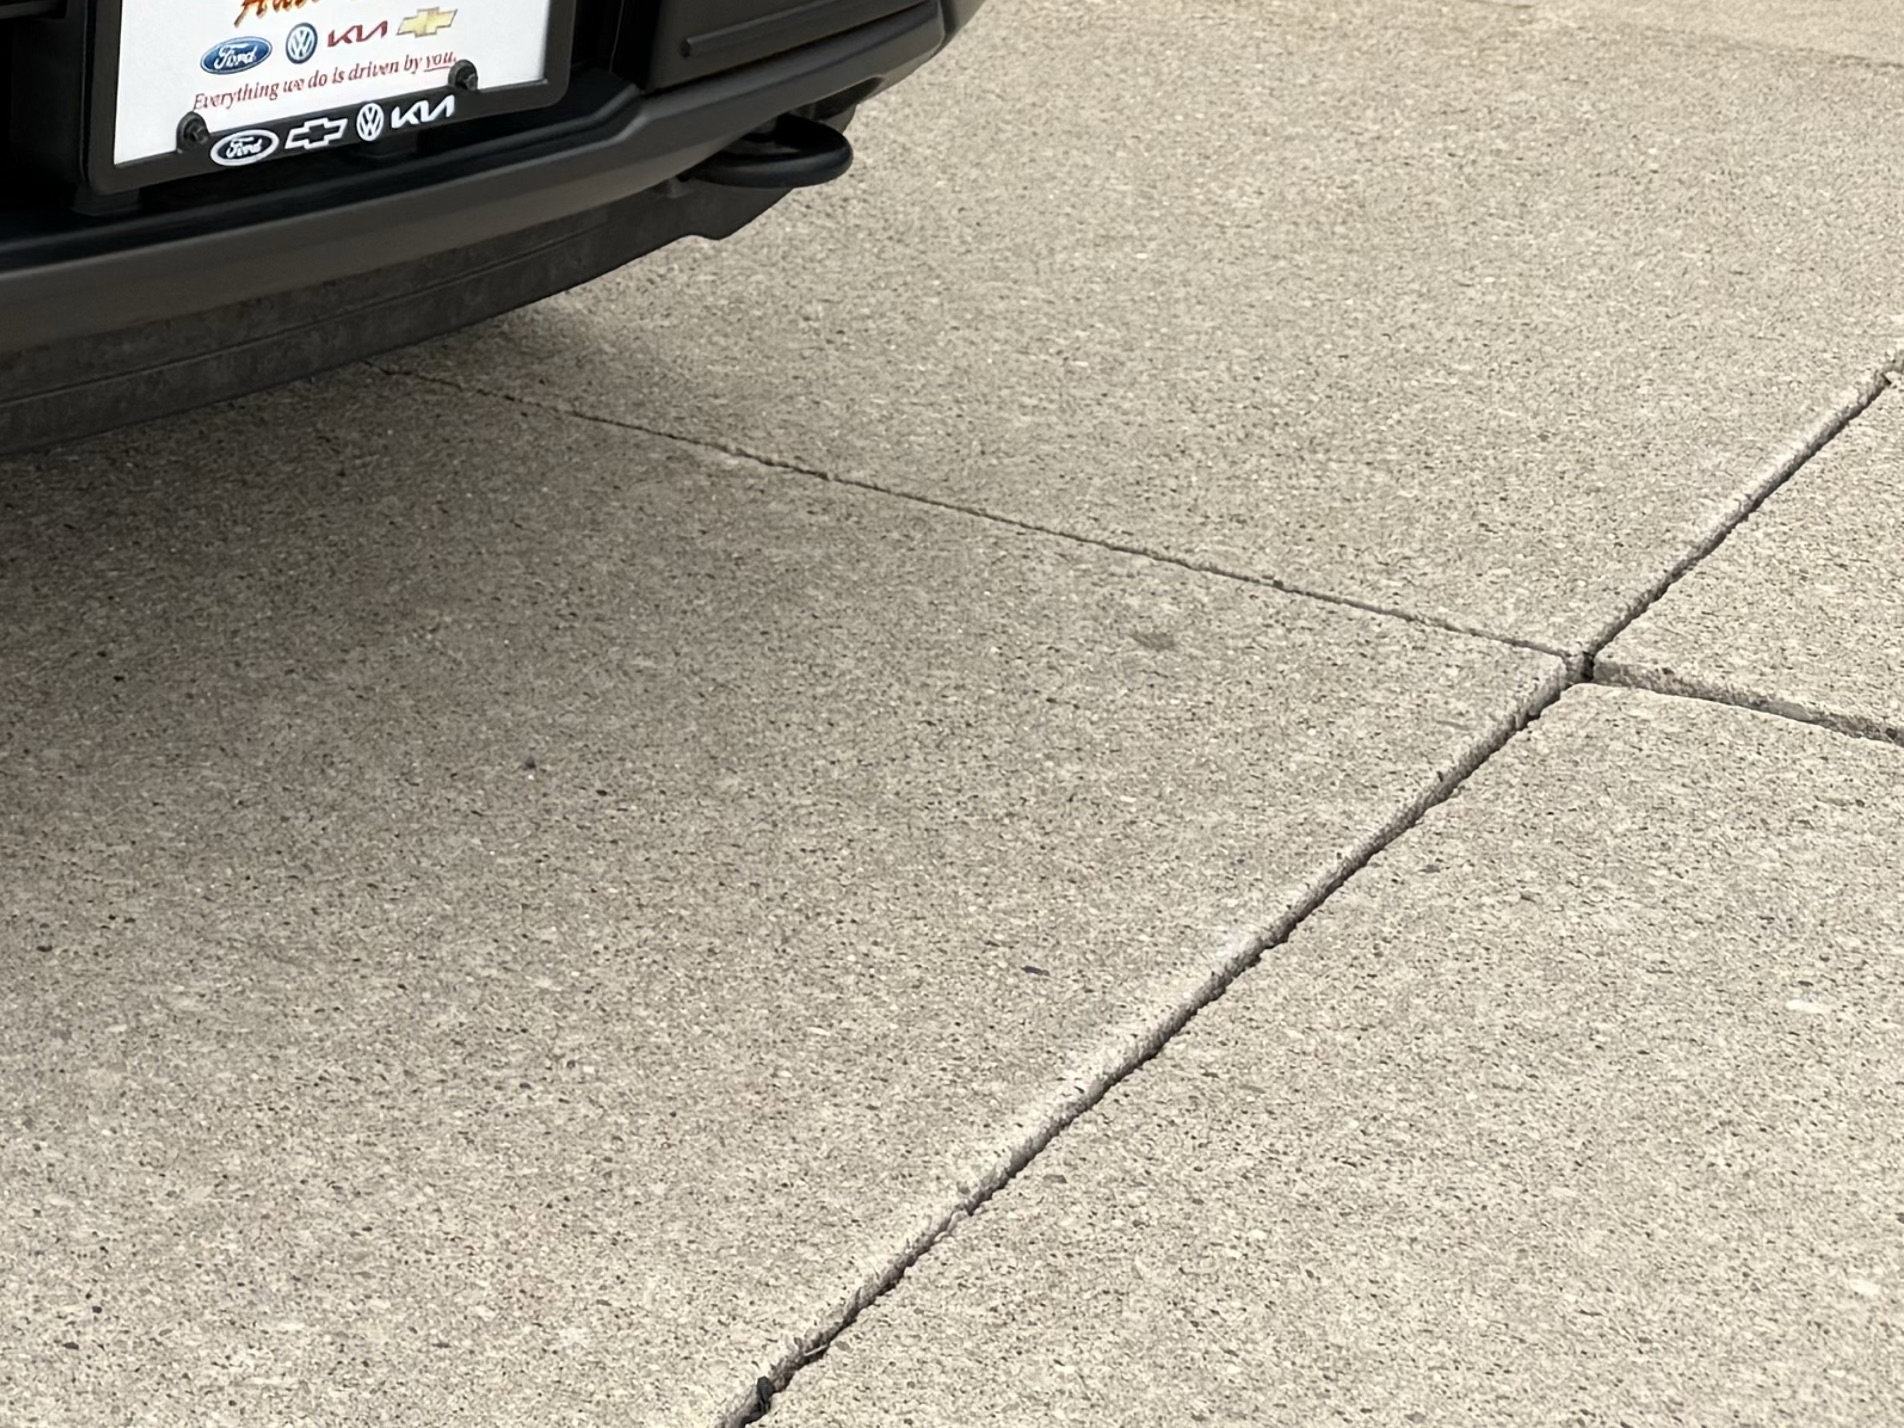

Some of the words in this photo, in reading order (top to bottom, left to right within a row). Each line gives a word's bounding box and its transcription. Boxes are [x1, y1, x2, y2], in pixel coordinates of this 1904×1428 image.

[193, 80, 280, 112] Everything
[282, 78, 305, 93] we
[307, 70, 328, 89] do
[332, 67, 345, 85] is
[347, 58, 400, 82] driven
[403, 53, 423, 76] by
